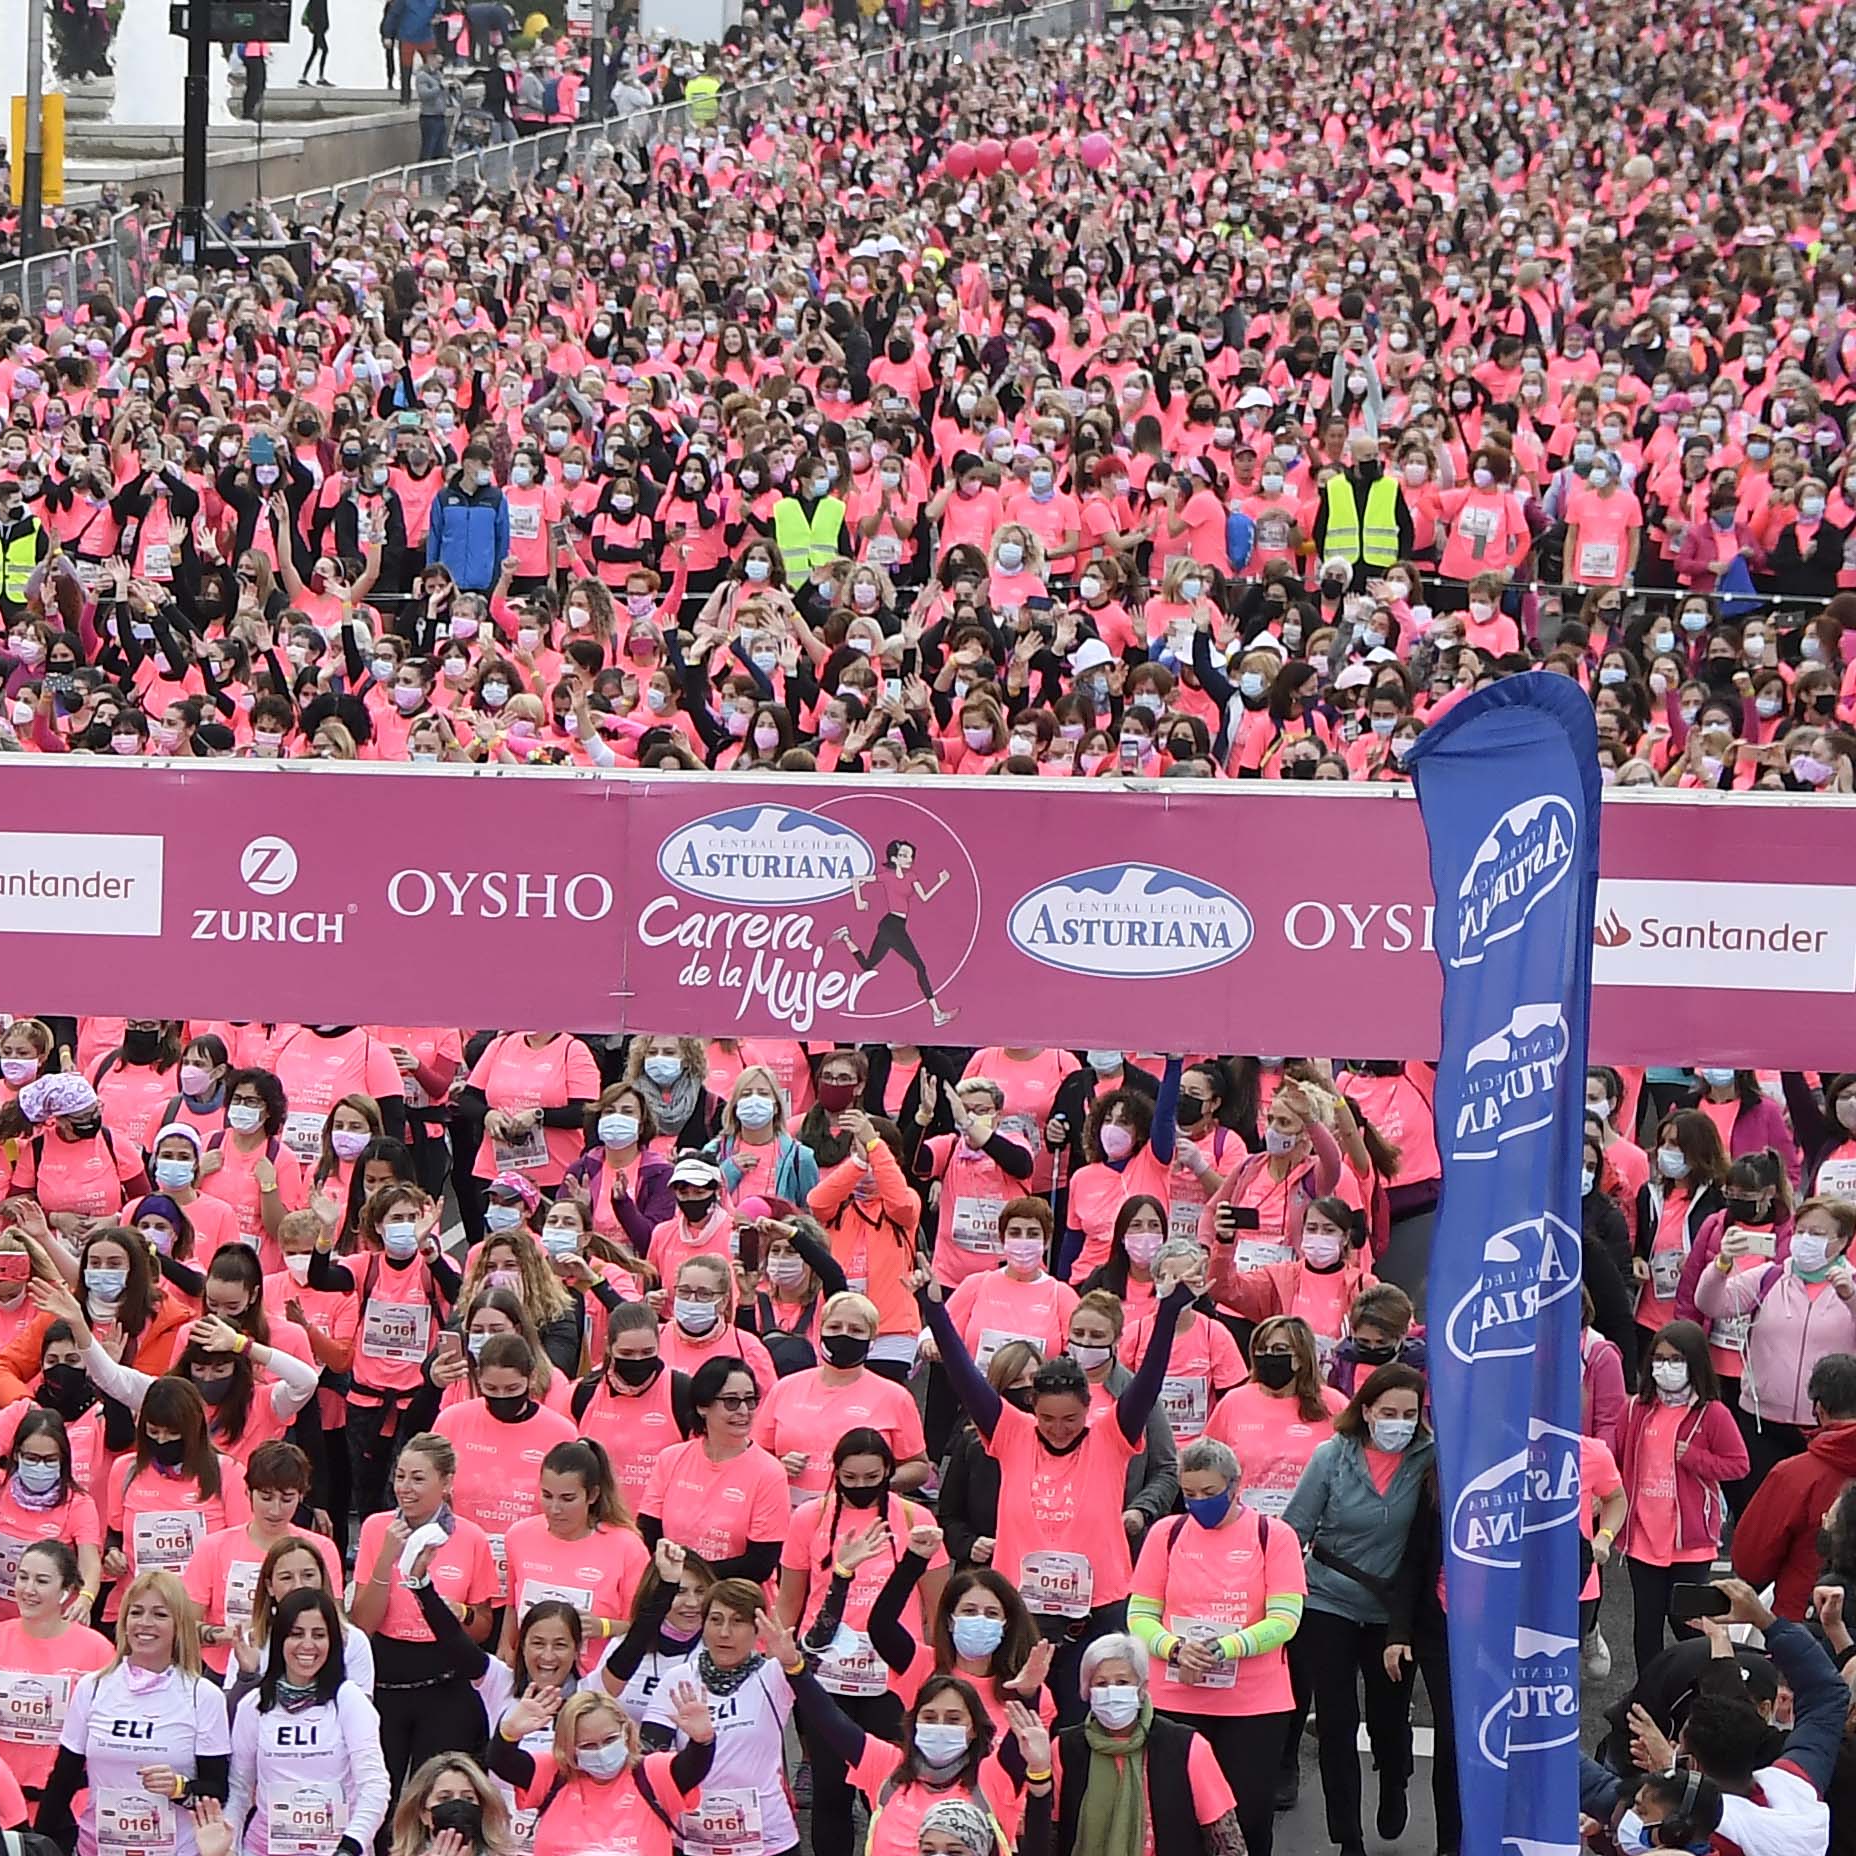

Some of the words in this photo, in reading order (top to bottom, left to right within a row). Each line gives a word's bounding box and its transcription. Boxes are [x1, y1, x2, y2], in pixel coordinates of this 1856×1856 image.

[674, 840, 854, 880] ASTURIANA
[387, 869, 613, 921] OYSHO
[1065, 901, 1140, 913] CENTRAL
[1149, 902, 1227, 915] LECHERA
[190, 909, 344, 943] ZURICH
[638, 895, 813, 950] Carrera
[1025, 902, 1233, 948] ASTURIANA
[1639, 918, 1829, 953] Santander
[679, 950, 712, 986] de
[718, 951, 743, 987] la
[734, 946, 877, 1032] Mujer
[298, 1132, 319, 1142] 016
[383, 1324, 409, 1335] 016
[157, 1536, 185, 1548] 016
[1041, 1576, 1070, 1590] 016
[11, 1701, 43, 1713] 016
[112, 1720, 153, 1740] ELI
[277, 1725, 317, 1746] ELI
[119, 1818, 151, 1831] 016
[293, 1812, 324, 1824] 016
[703, 1819, 736, 1830] 016
